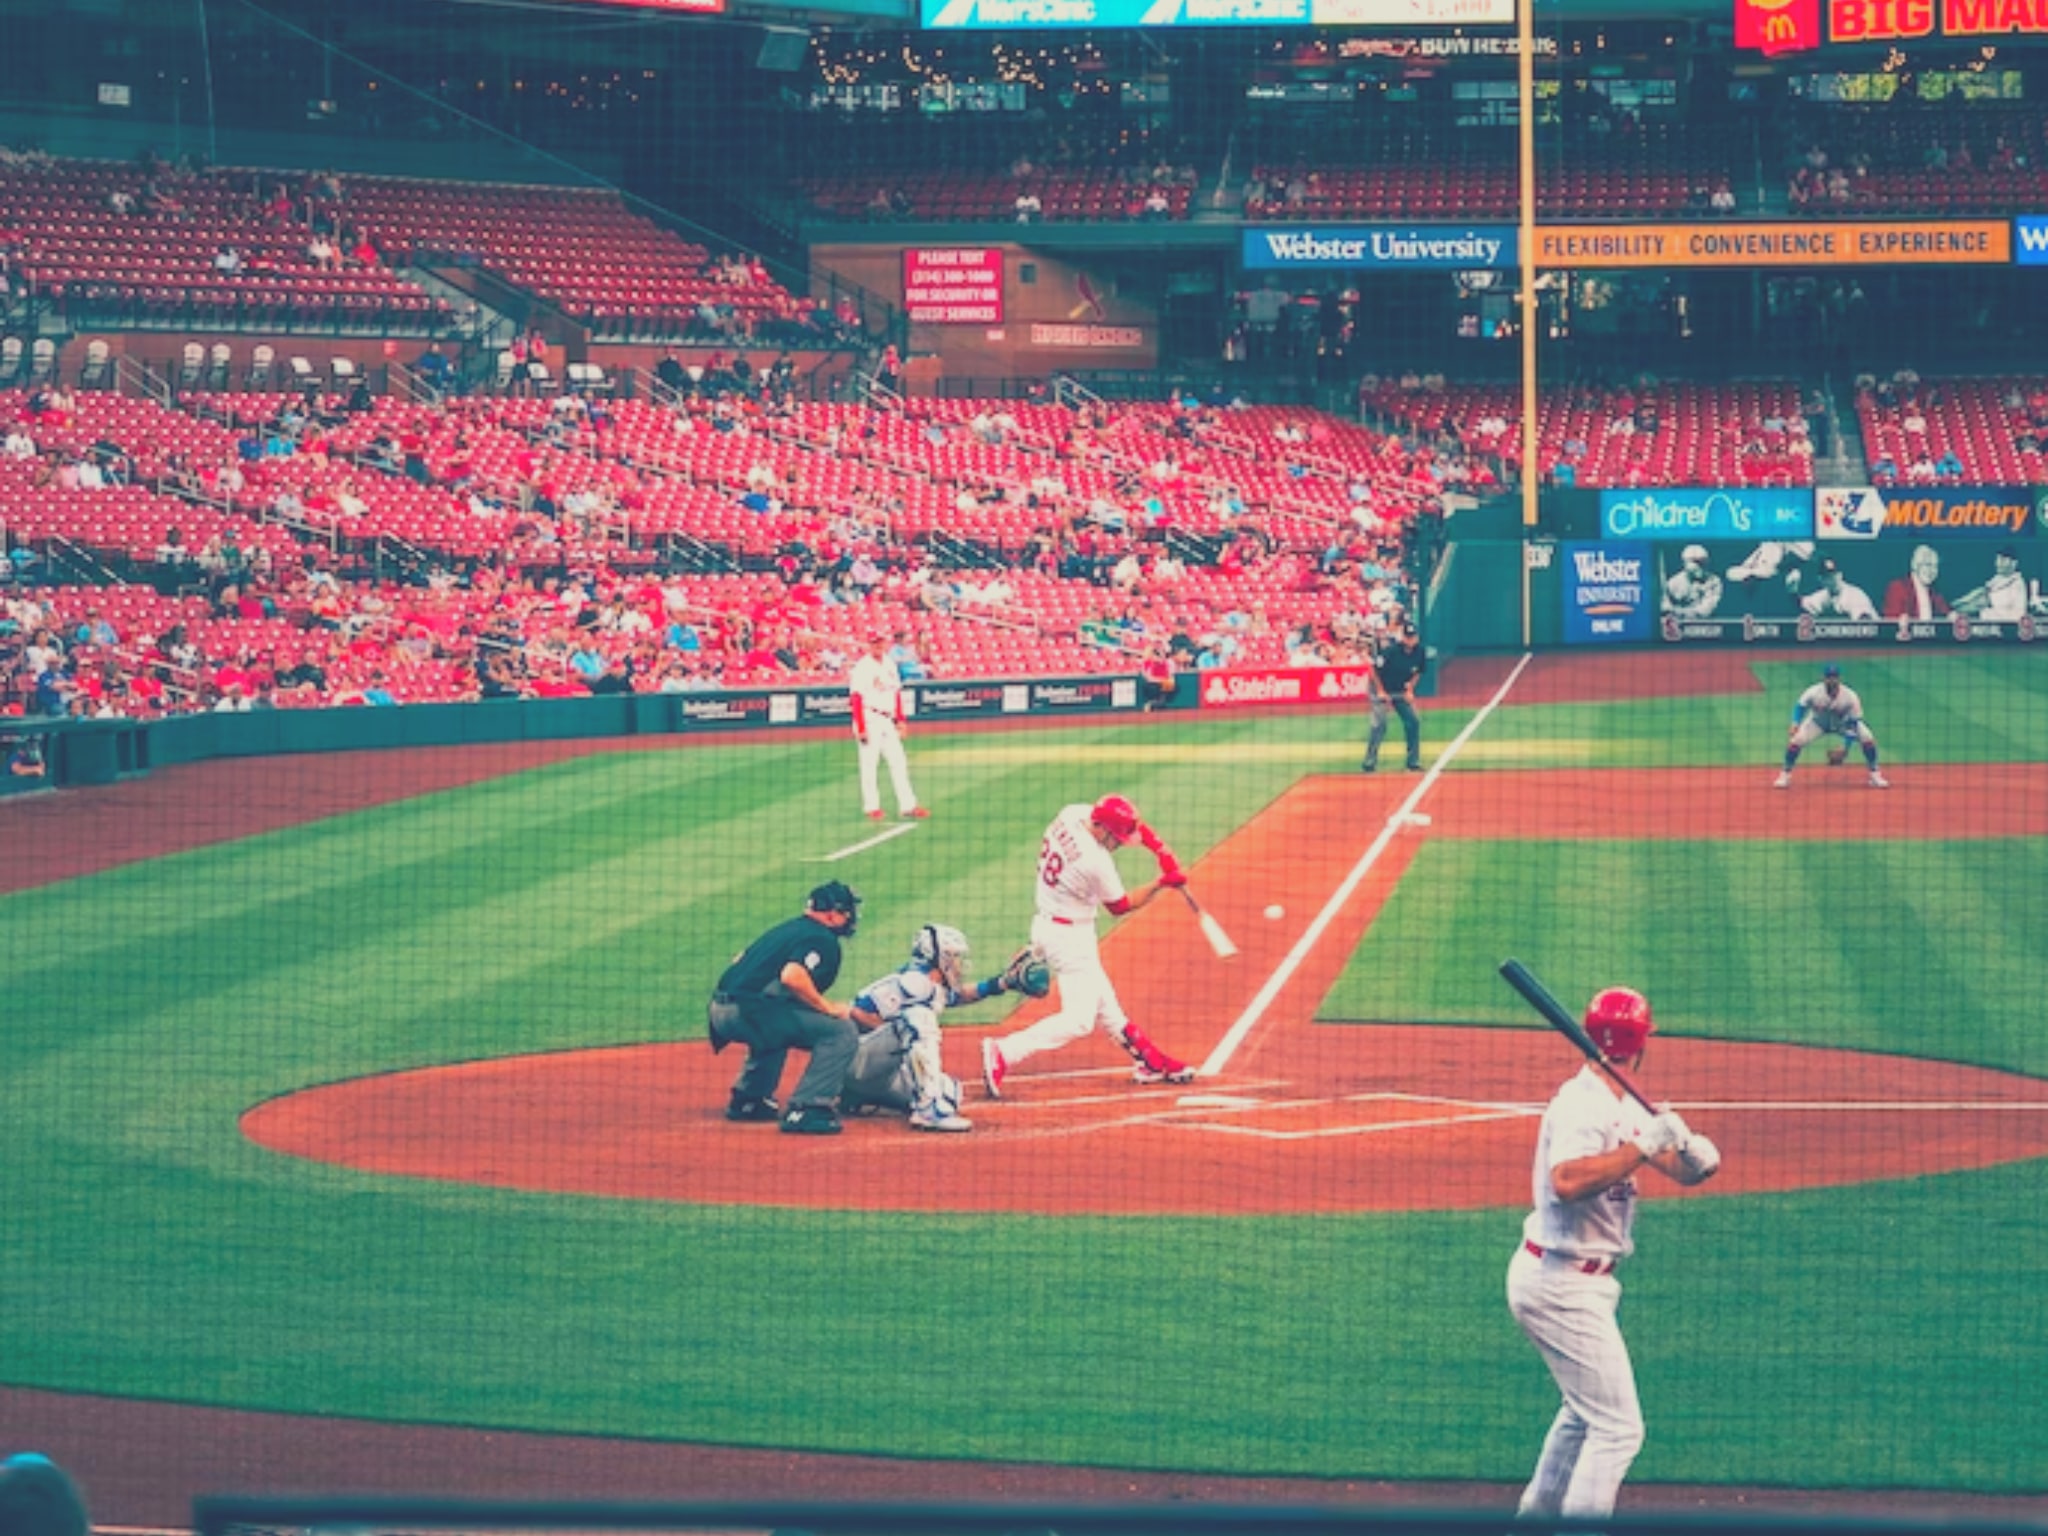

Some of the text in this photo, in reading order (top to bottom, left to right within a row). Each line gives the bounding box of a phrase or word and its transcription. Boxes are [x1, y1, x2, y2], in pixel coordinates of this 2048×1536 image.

[1266, 232, 1501, 265] Webster University
[1543, 231, 1989, 256] FLEXIBILITY CONVENIENCE EXPERIENCE
[1574, 551, 1640, 583] Webster
[1576, 586, 1640, 605] UNIVERSITY
